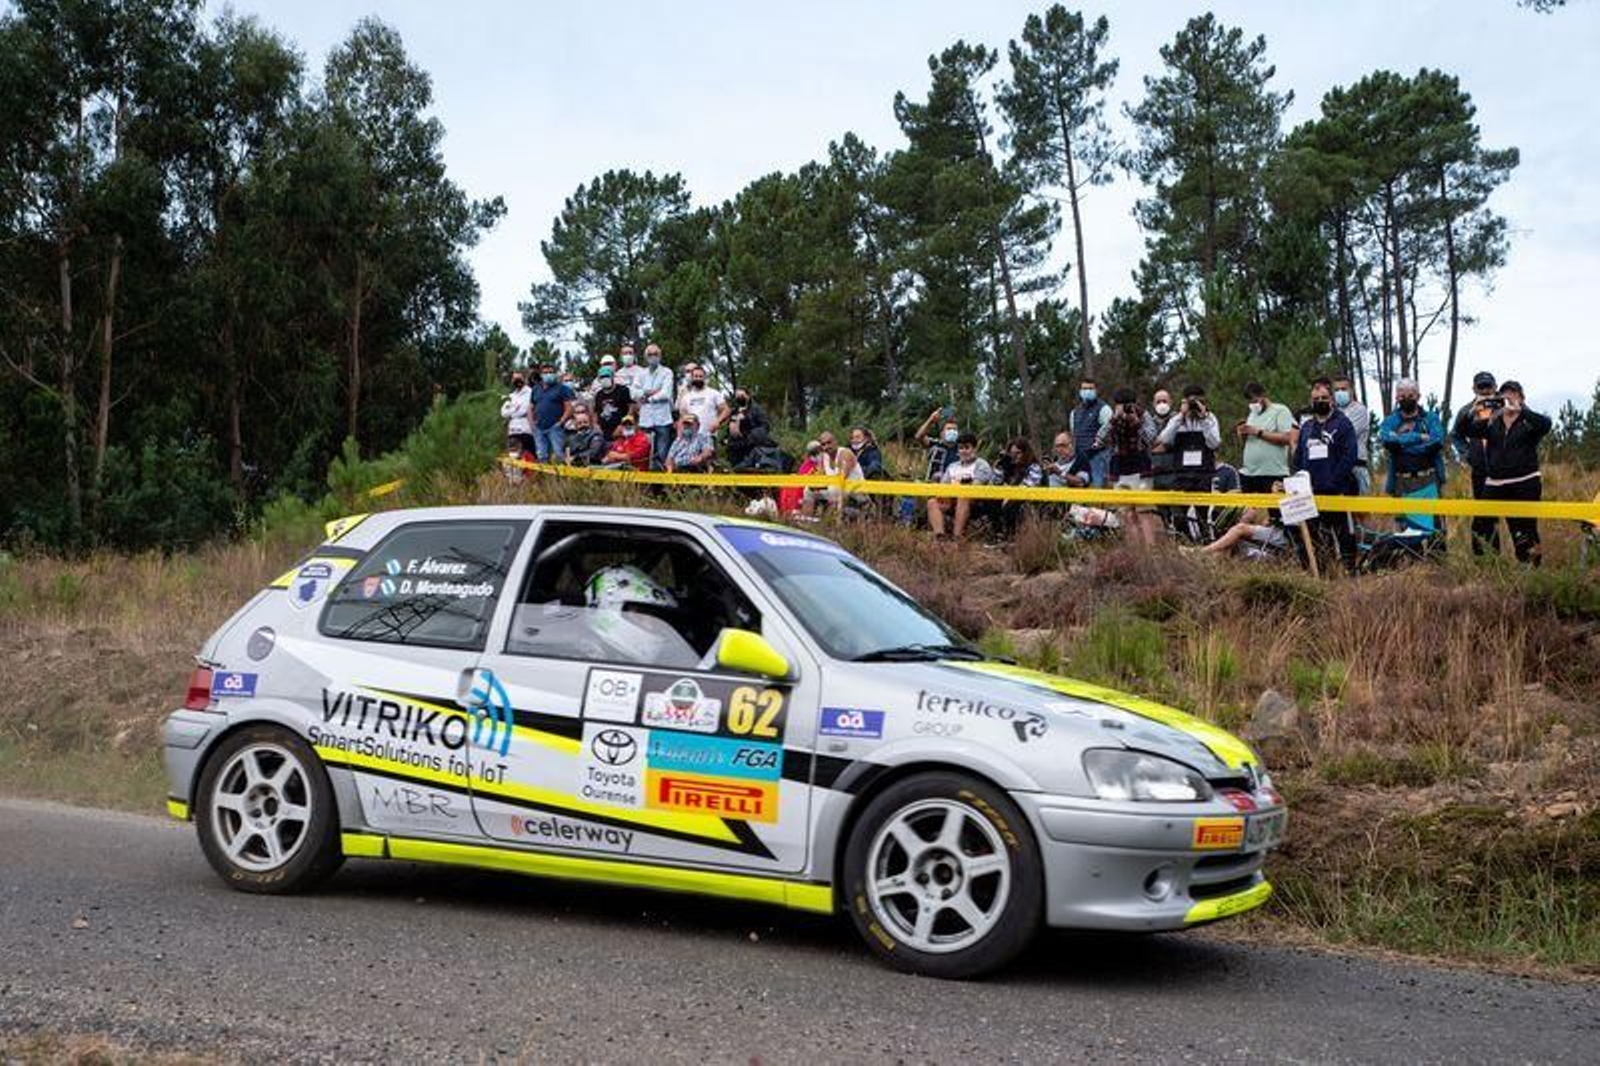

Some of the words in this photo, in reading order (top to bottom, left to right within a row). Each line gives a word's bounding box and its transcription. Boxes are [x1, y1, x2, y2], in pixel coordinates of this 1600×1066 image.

[406, 559, 418, 574] F.
[419, 556, 468, 575] Álvarez
[400, 580, 413, 594] D.
[415, 580, 494, 598] Monteagudo
[322, 687, 469, 750] VITRIKO
[726, 686, 784, 738] 62
[308, 726, 442, 772] SmartSolutions
[449, 754, 474, 777] for
[480, 761, 508, 785] IoT
[731, 748, 779, 769] FGA
[588, 766, 636, 788] Toyota
[372, 785, 458, 818] MBR
[582, 784, 637, 805] Ourense
[659, 777, 764, 815] PIRELLI
[524, 816, 634, 853] celerway
